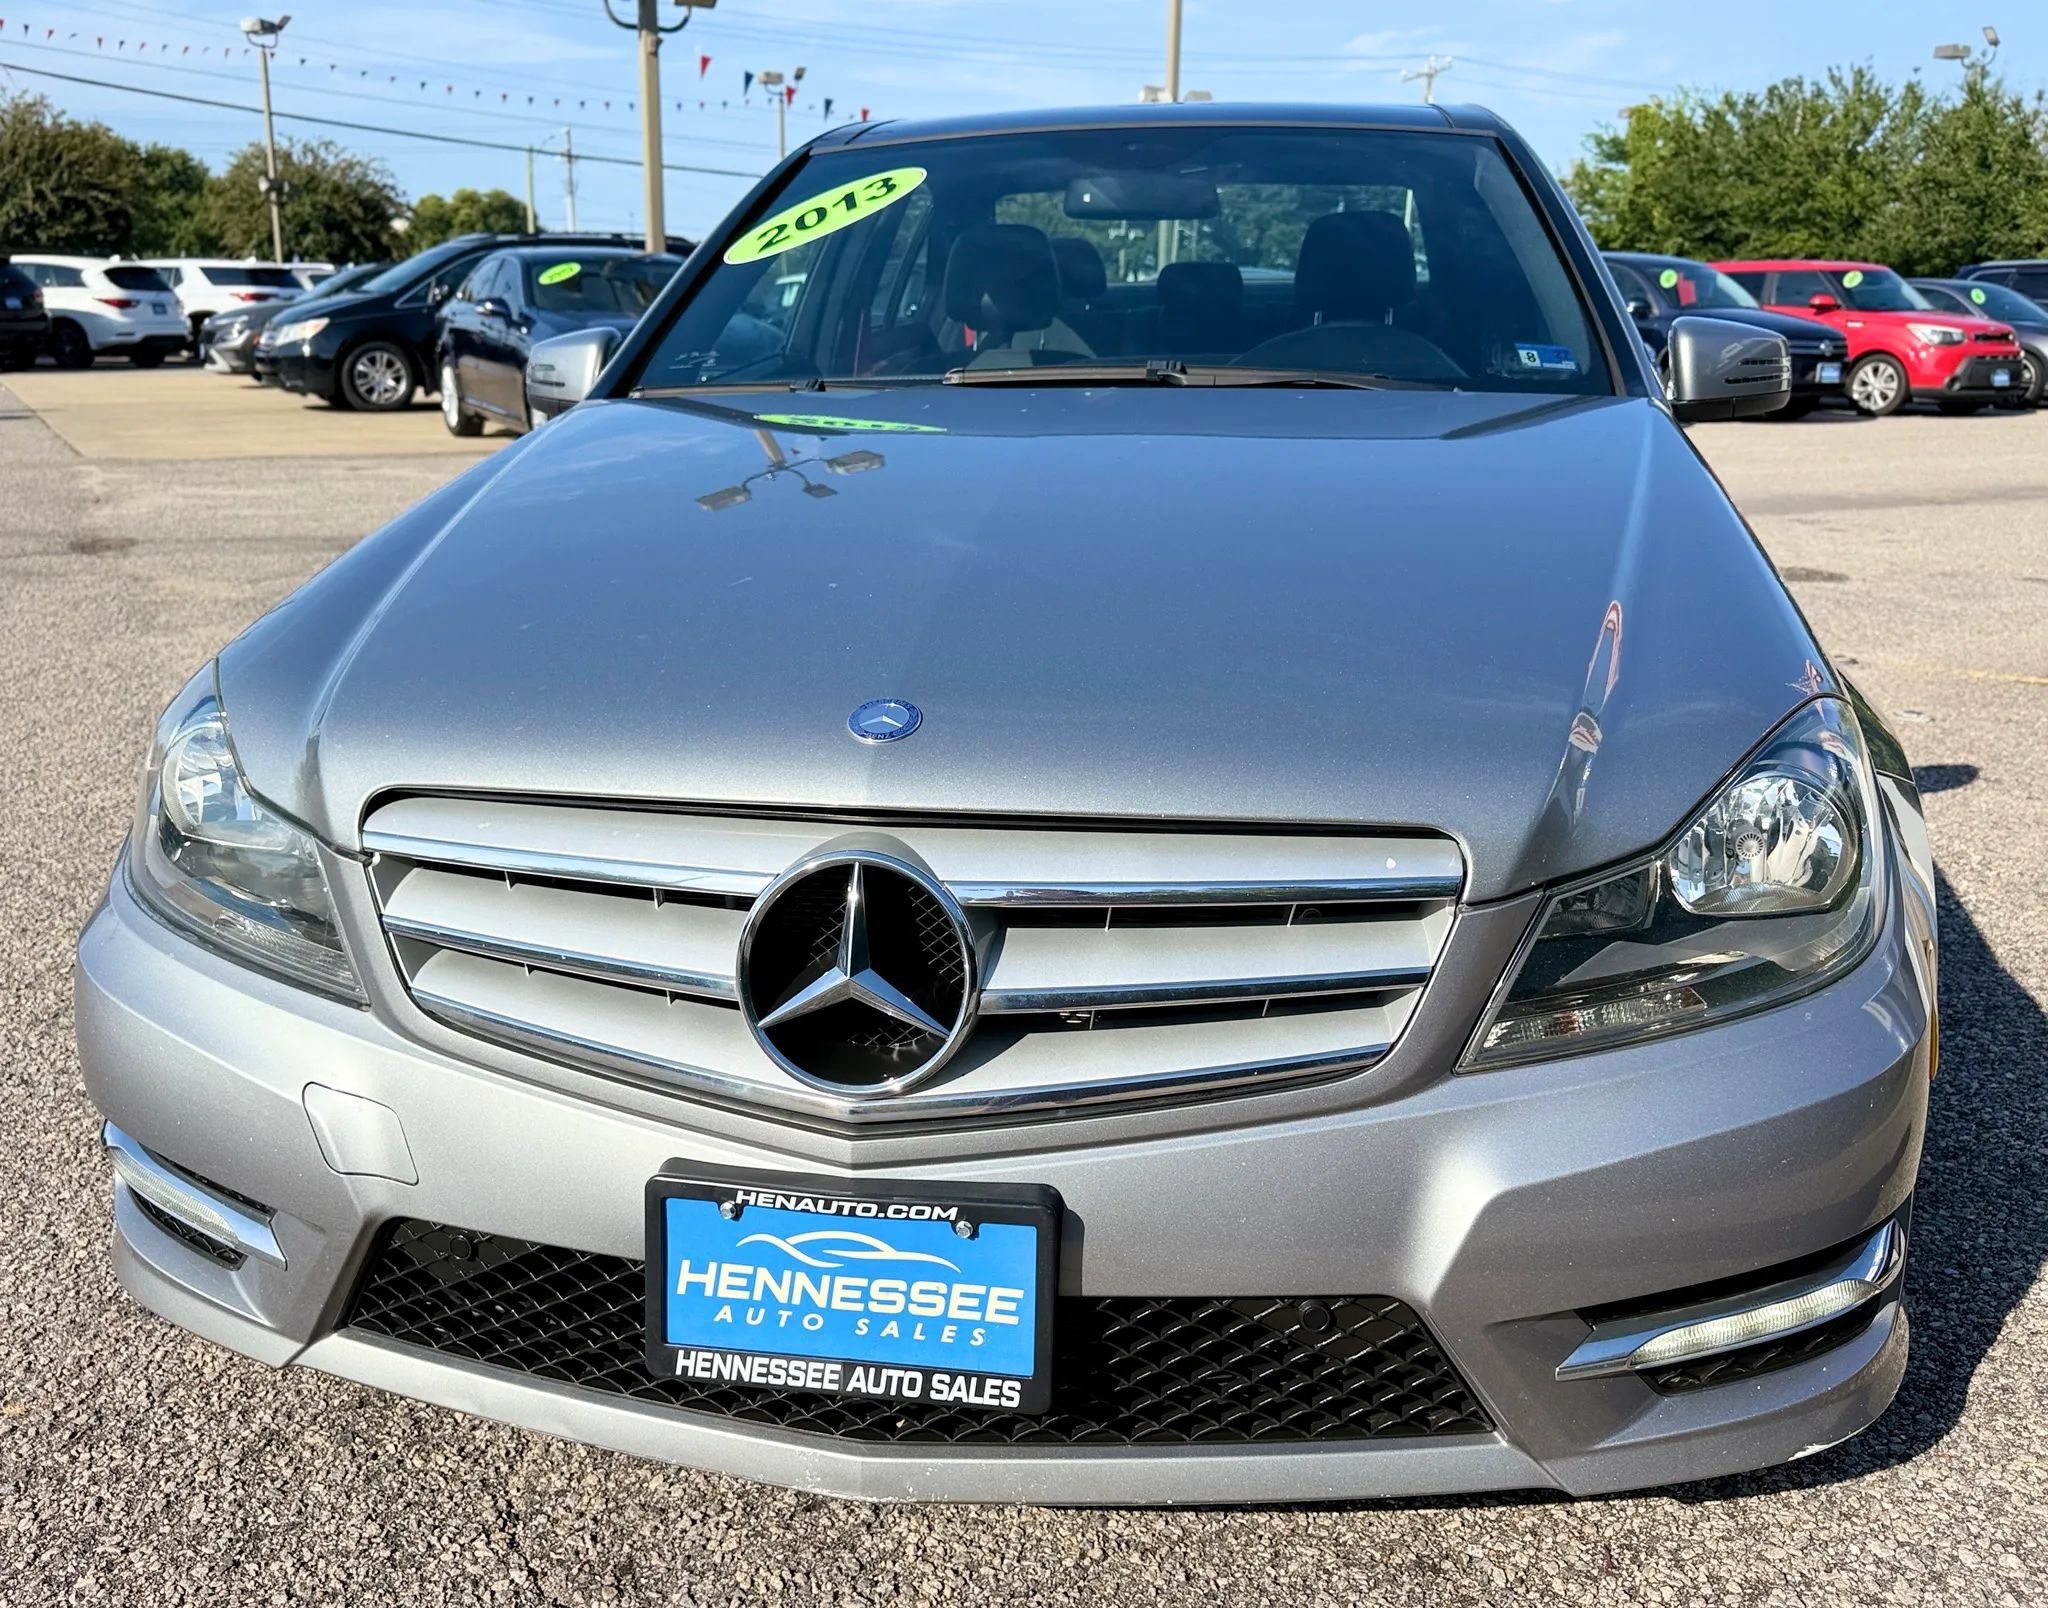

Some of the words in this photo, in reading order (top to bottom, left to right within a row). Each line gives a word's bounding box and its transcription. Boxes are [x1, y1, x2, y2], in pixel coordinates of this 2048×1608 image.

[756, 176, 898, 253] 2013
[1526, 351, 1536, 363] 8
[734, 1189, 959, 1221] HENAUTO.COM
[676, 1259, 1025, 1325] HENNESSEE
[713, 1305, 825, 1331] AUTO
[854, 1318, 986, 1346] SALES
[675, 1349, 842, 1391] HENNESSEE
[846, 1366, 923, 1398] AUTO
[929, 1374, 1022, 1408] SALES
